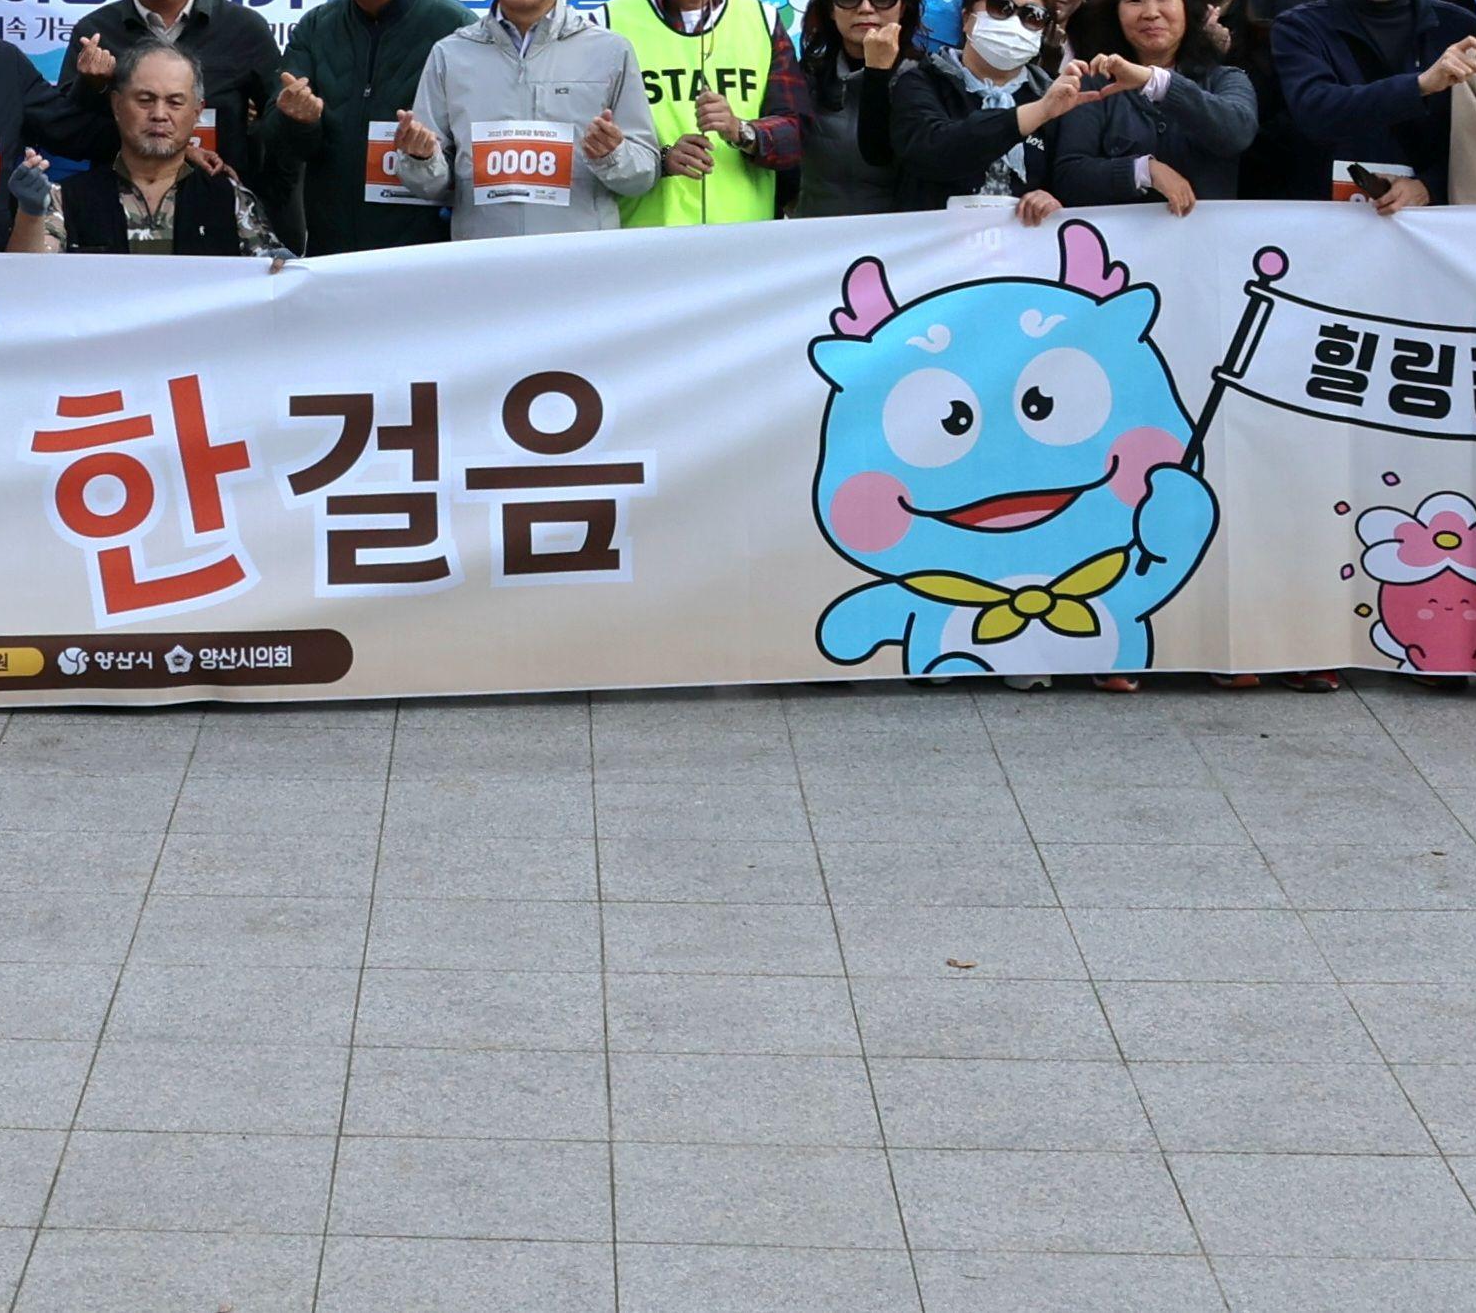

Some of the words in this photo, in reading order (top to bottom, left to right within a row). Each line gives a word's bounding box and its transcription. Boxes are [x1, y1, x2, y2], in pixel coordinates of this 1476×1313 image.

[642, 68, 757, 105] STAFF
[486, 149, 557, 176] 0008
[30, 374, 252, 614] 한
[287, 369, 647, 586] 걸음
[93, 650, 154, 670] 양산시
[197, 645, 293, 670] 양산시의회
